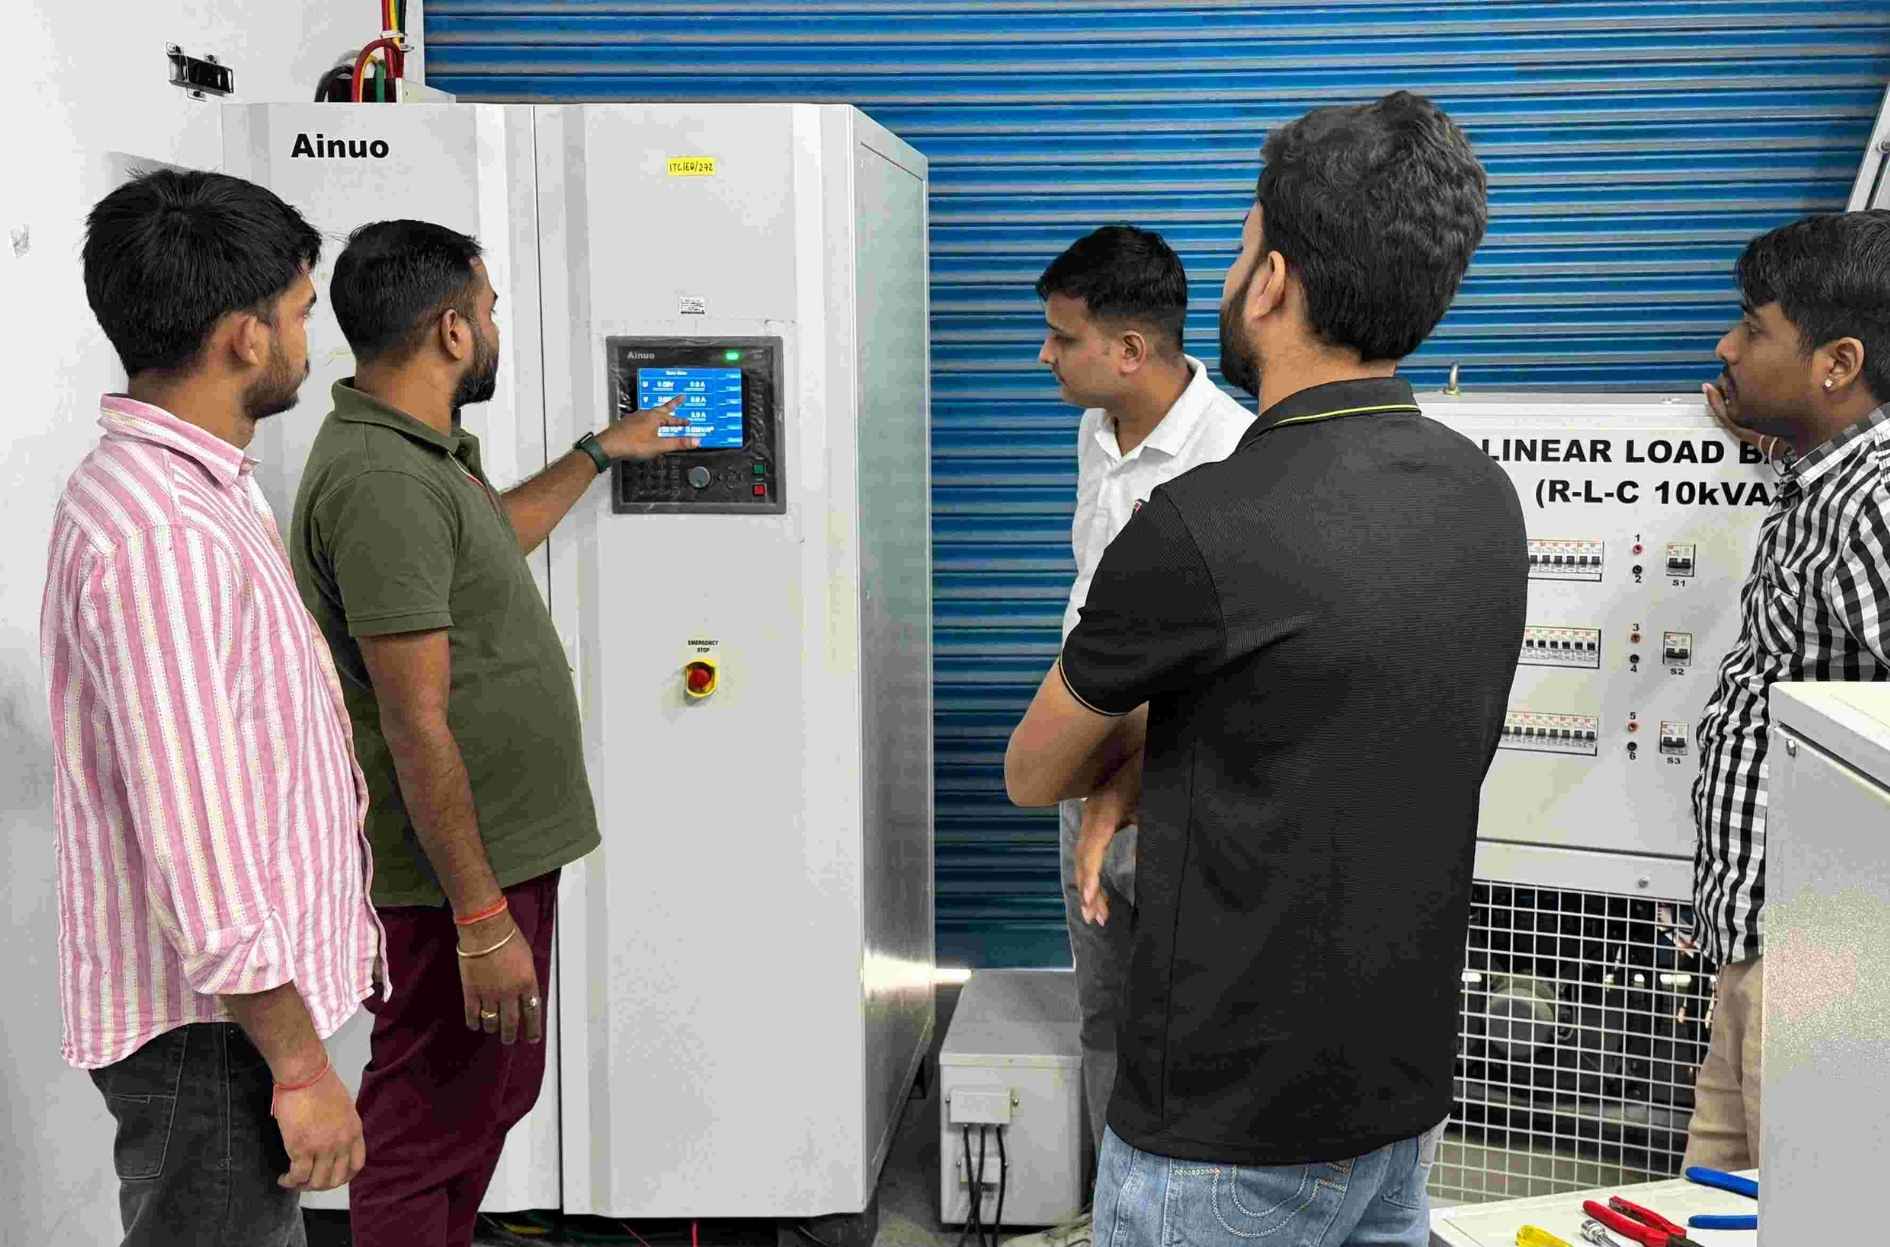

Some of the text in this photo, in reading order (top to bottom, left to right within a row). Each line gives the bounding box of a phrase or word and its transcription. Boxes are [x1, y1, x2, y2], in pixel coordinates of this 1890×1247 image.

[291, 133, 389, 158] Ainuo
[627, 351, 655, 360] Ainuo
[1482, 439, 1612, 463] LINEAR
[1625, 440, 1725, 464] LOAD
[1536, 479, 1780, 509] (R-L-C 10kVA
[1635, 575, 1642, 584] 2
[1632, 623, 1640, 631] 3
[1630, 664, 1637, 673] 4
[1670, 668, 1685, 676] S2
[1630, 712, 1636, 720] 5
[1630, 752, 1637, 761] 6
[1667, 757, 1681, 765] S3
